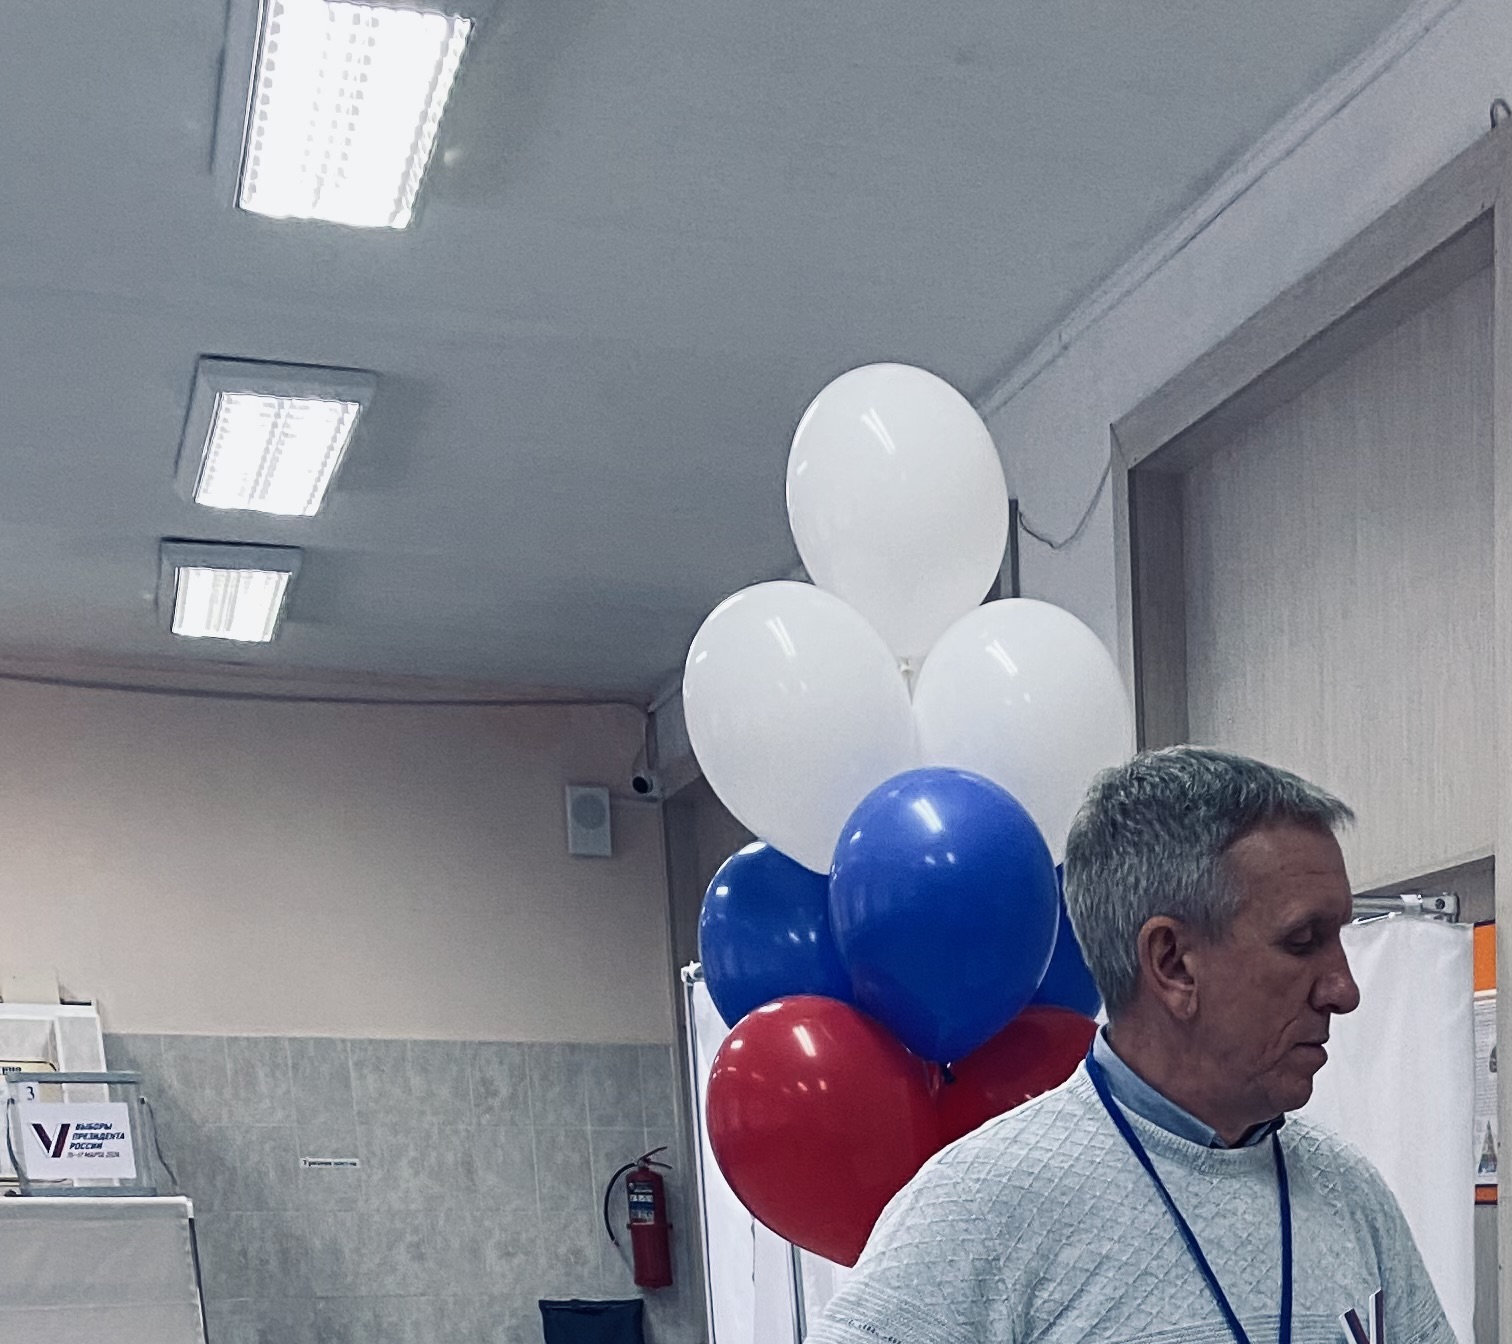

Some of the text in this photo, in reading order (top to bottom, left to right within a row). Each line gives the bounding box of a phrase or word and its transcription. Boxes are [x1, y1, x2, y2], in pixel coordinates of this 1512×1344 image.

[75, 1123, 113, 1131] ВЫБОРЫ
[72, 1132, 125, 1141] ПРЕЗИДЕНТА
[69, 1142, 103, 1150] РОССИИ
